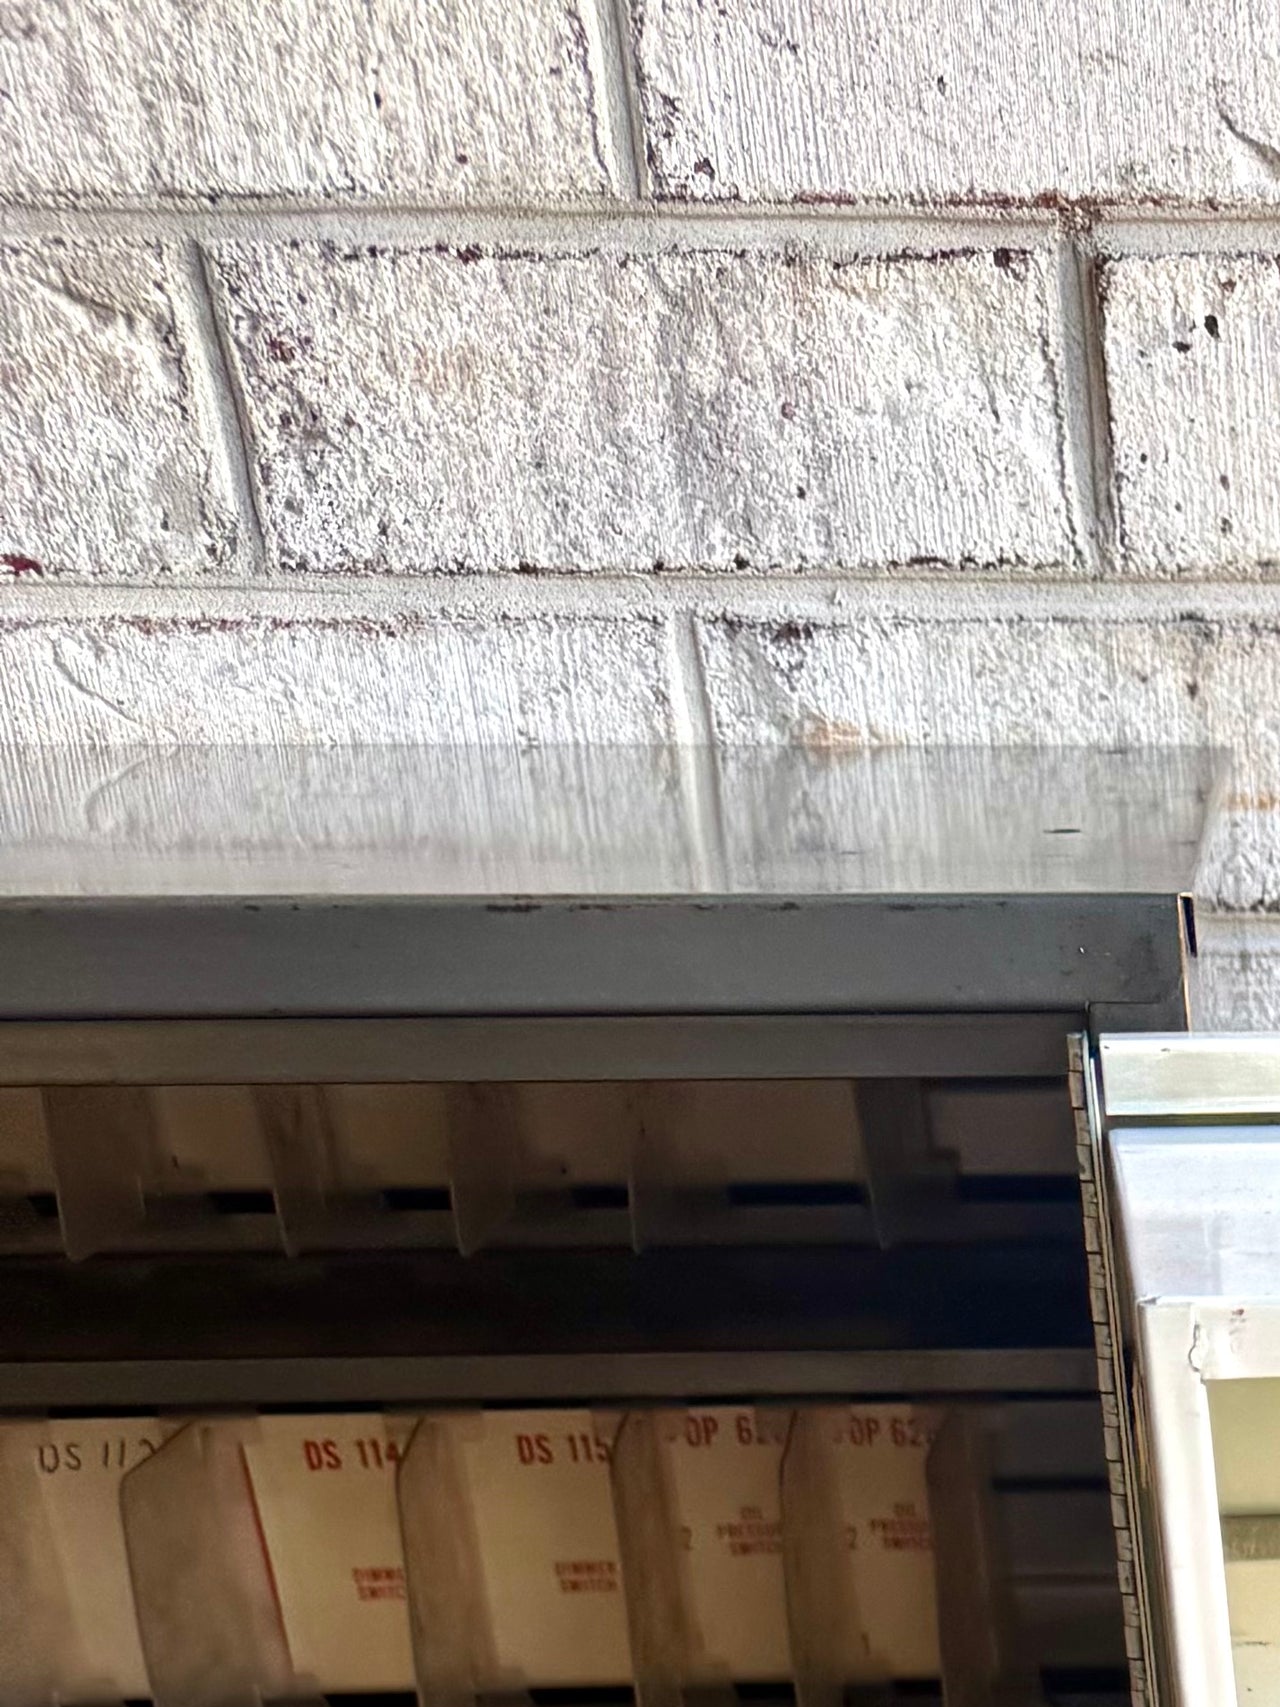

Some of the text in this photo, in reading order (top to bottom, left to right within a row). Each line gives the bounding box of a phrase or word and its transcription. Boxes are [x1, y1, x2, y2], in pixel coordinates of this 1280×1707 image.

[303, 1439, 342, 1471] DS
[516, 1431, 612, 1465] DS 115
